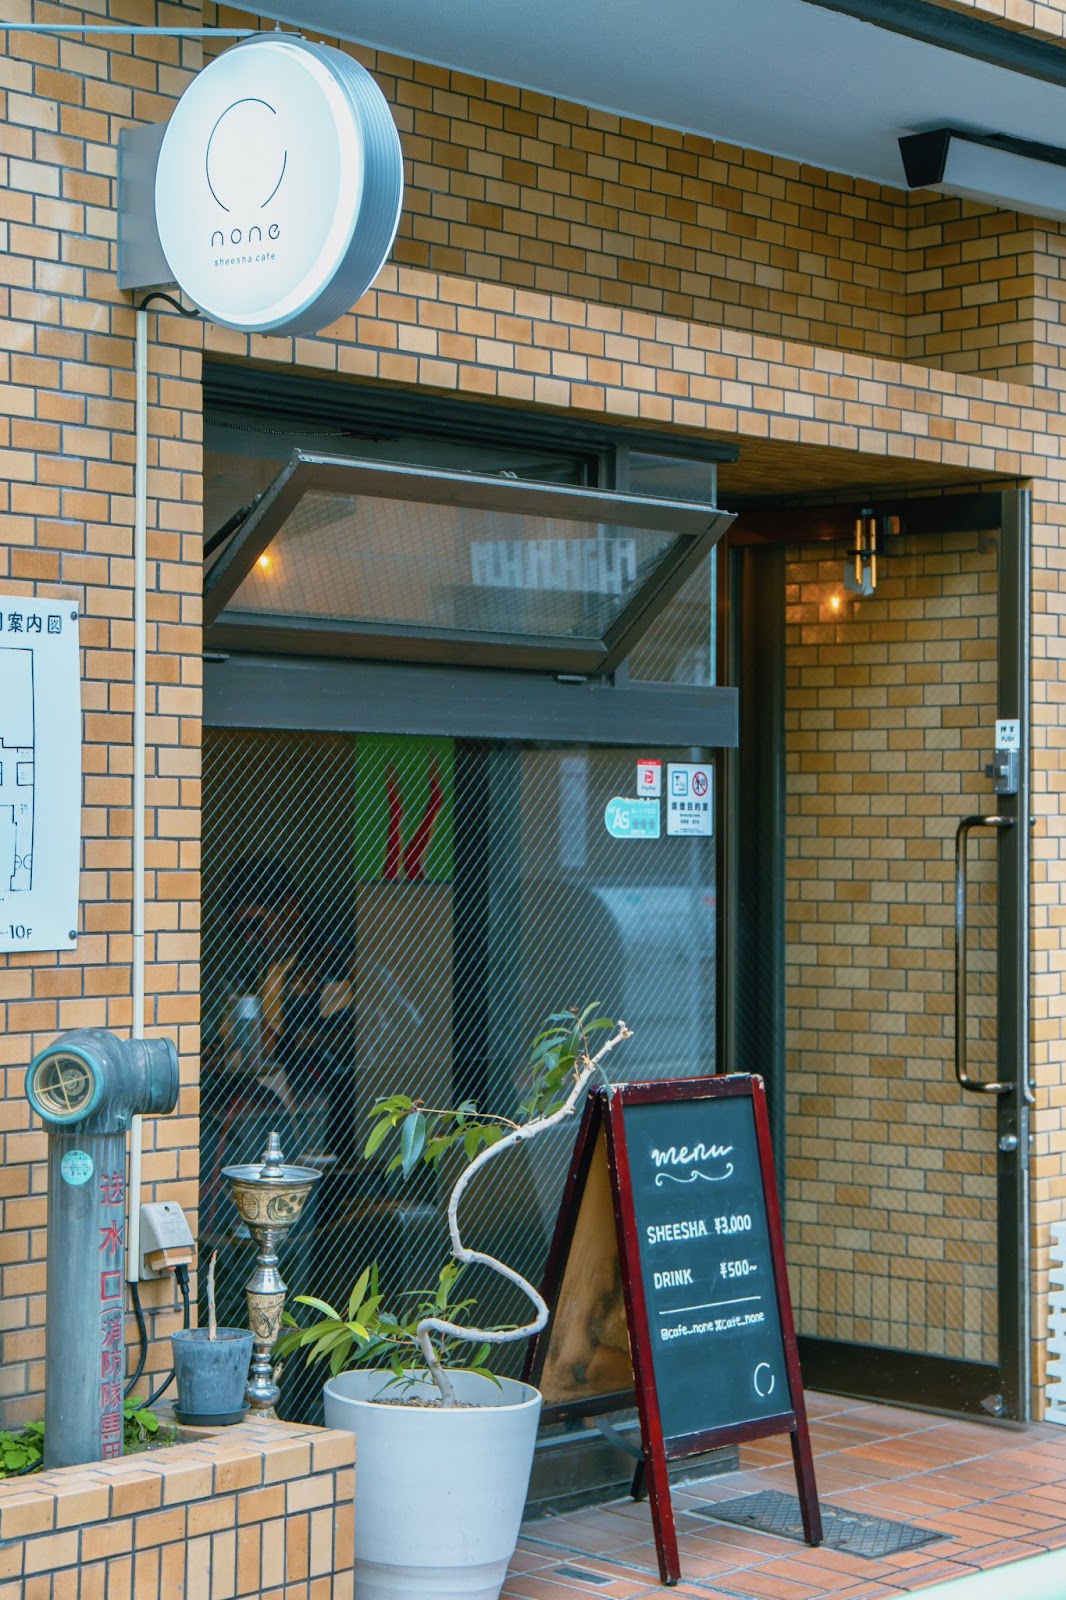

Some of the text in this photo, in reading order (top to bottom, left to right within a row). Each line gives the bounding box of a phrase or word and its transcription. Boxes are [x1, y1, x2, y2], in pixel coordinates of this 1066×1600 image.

[211, 223, 281, 247] none
[214, 251, 276, 267] sheesha cafe
[0, 611, 63, 634] 案内図
[650, 1142, 733, 1167] menu
[646, 1219, 708, 1244] SHEESHA
[653, 1268, 694, 1290] DRINK
